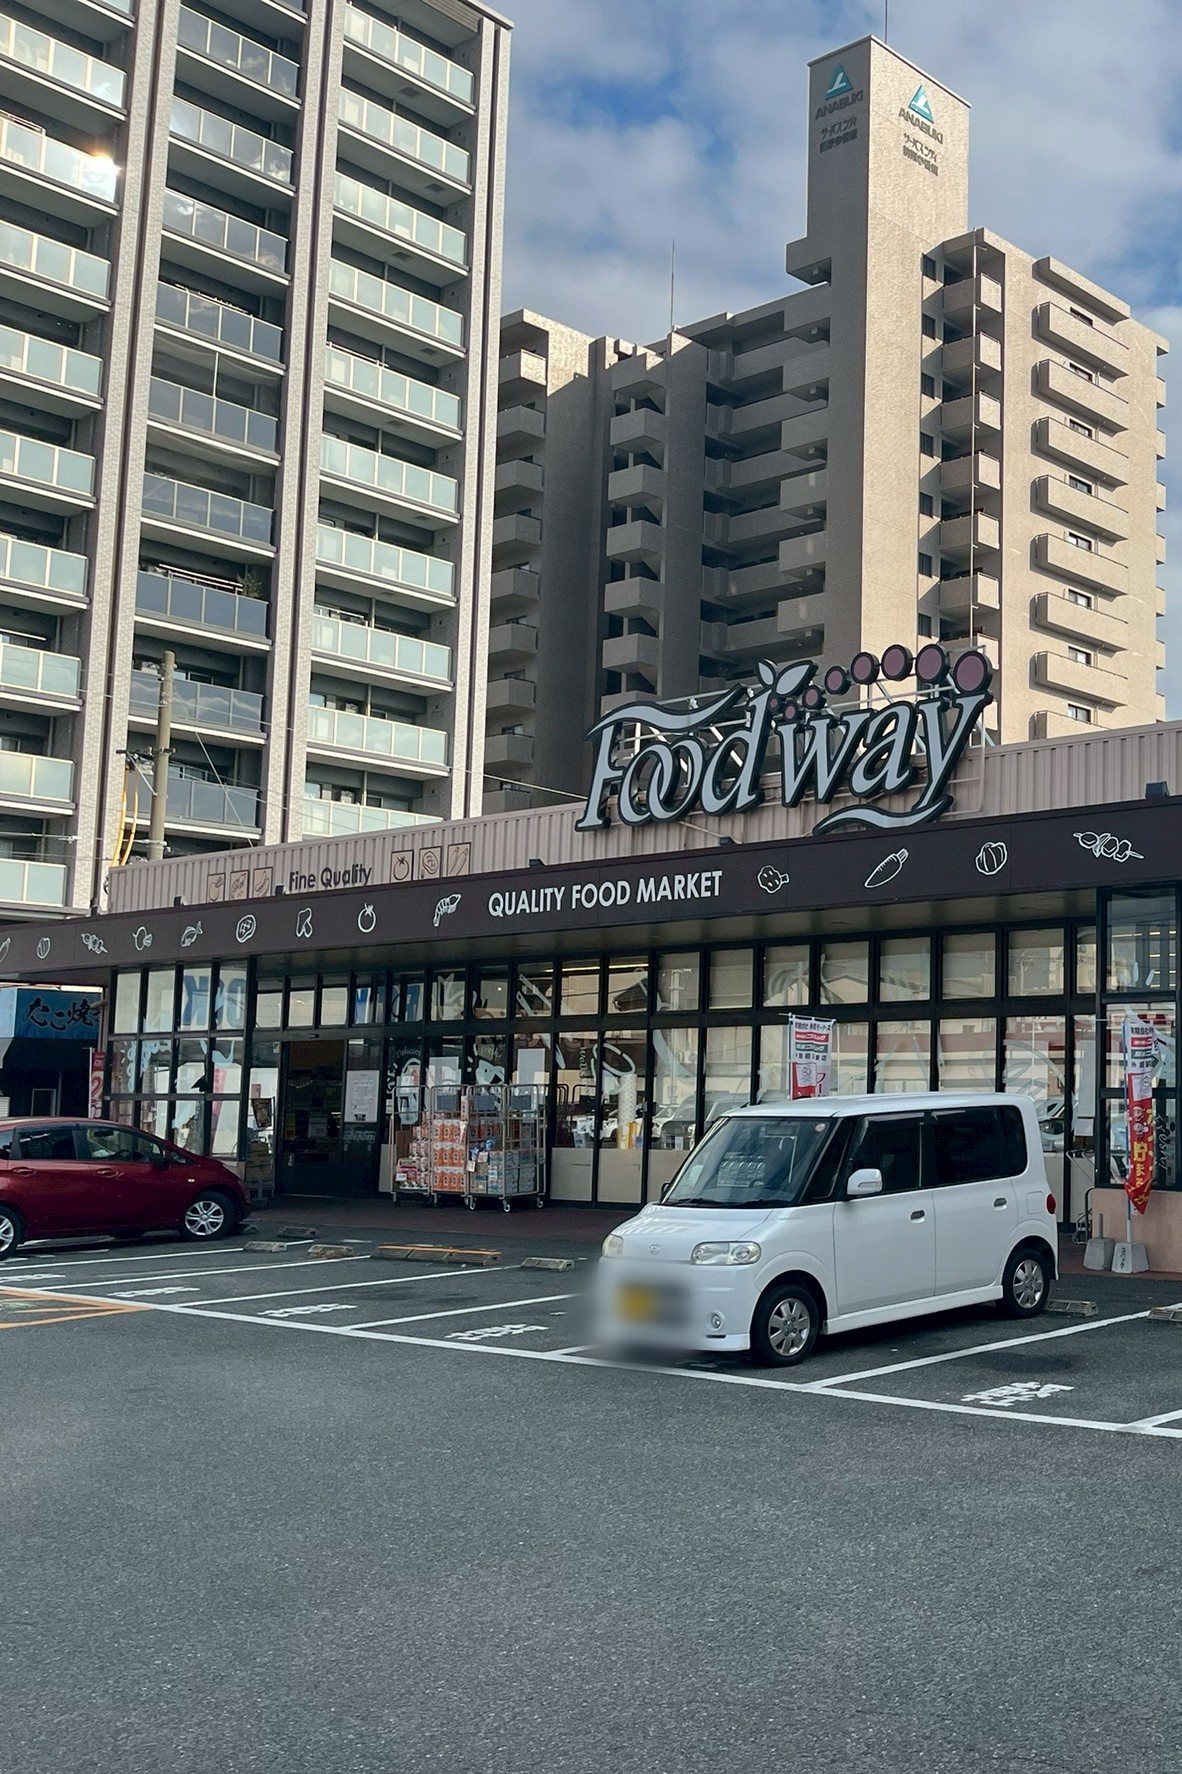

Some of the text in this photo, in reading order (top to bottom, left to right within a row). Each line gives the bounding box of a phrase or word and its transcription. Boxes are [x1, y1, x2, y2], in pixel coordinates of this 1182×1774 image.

[815, 90, 863, 120] ANABUKI
[899, 107, 943, 144] ANABUKI
[575, 662, 994, 836] Foodway
[289, 864, 372, 891] Fine Quality
[488, 870, 722, 917] QUALITY FOOD MARKET
